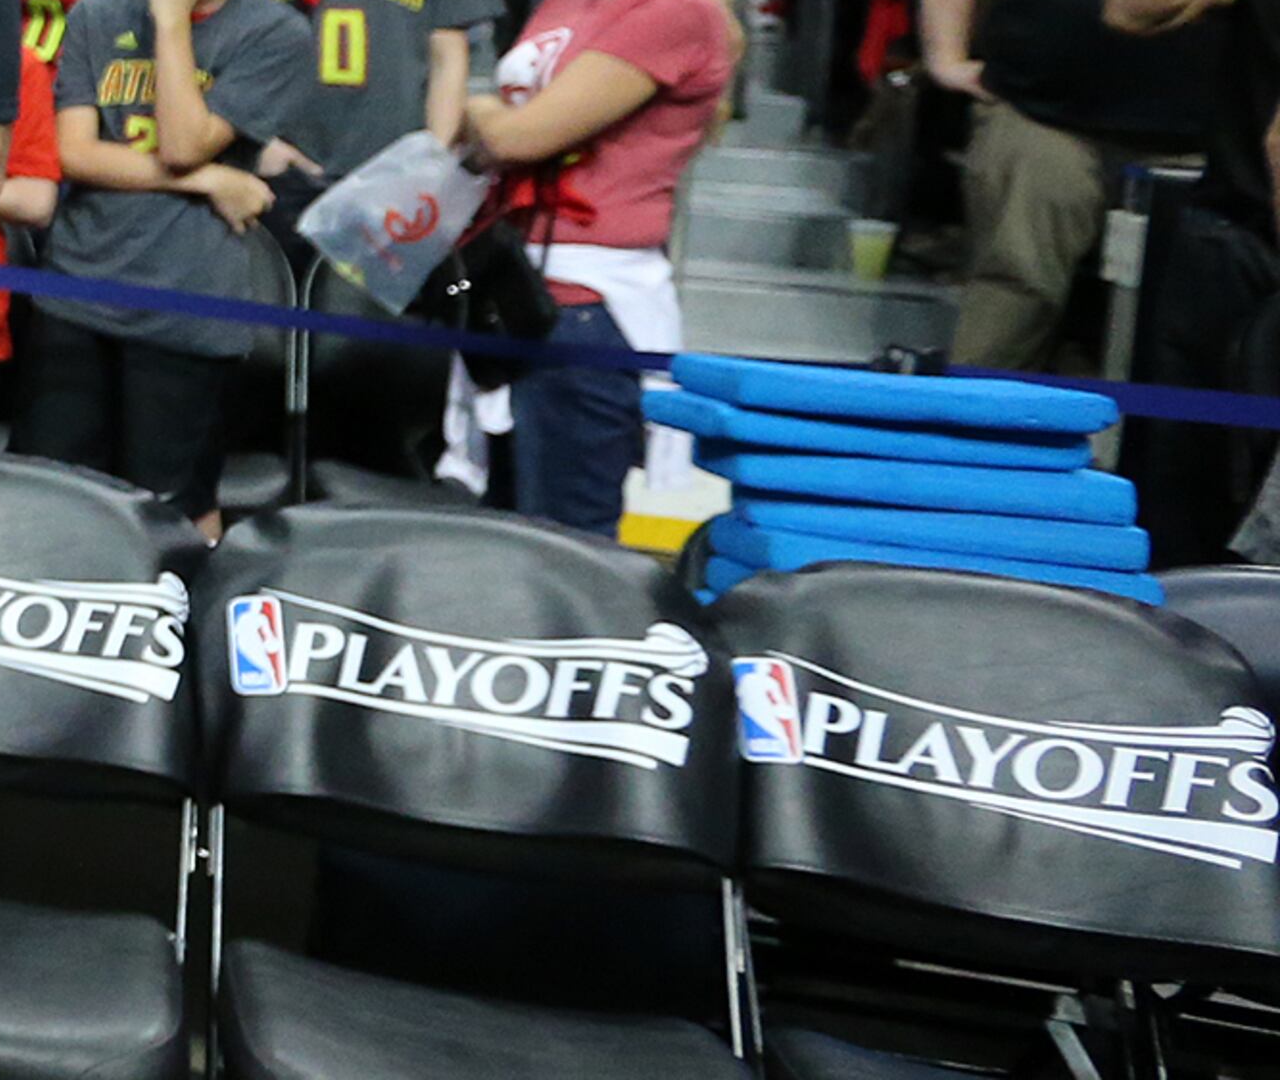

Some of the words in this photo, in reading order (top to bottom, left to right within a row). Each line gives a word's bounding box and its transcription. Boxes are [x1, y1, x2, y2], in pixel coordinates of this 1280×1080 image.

[320, 7, 368, 87] 0
[287, 622, 695, 730] PLAYOFFS
[802, 691, 1280, 822] PLAYOFFS
